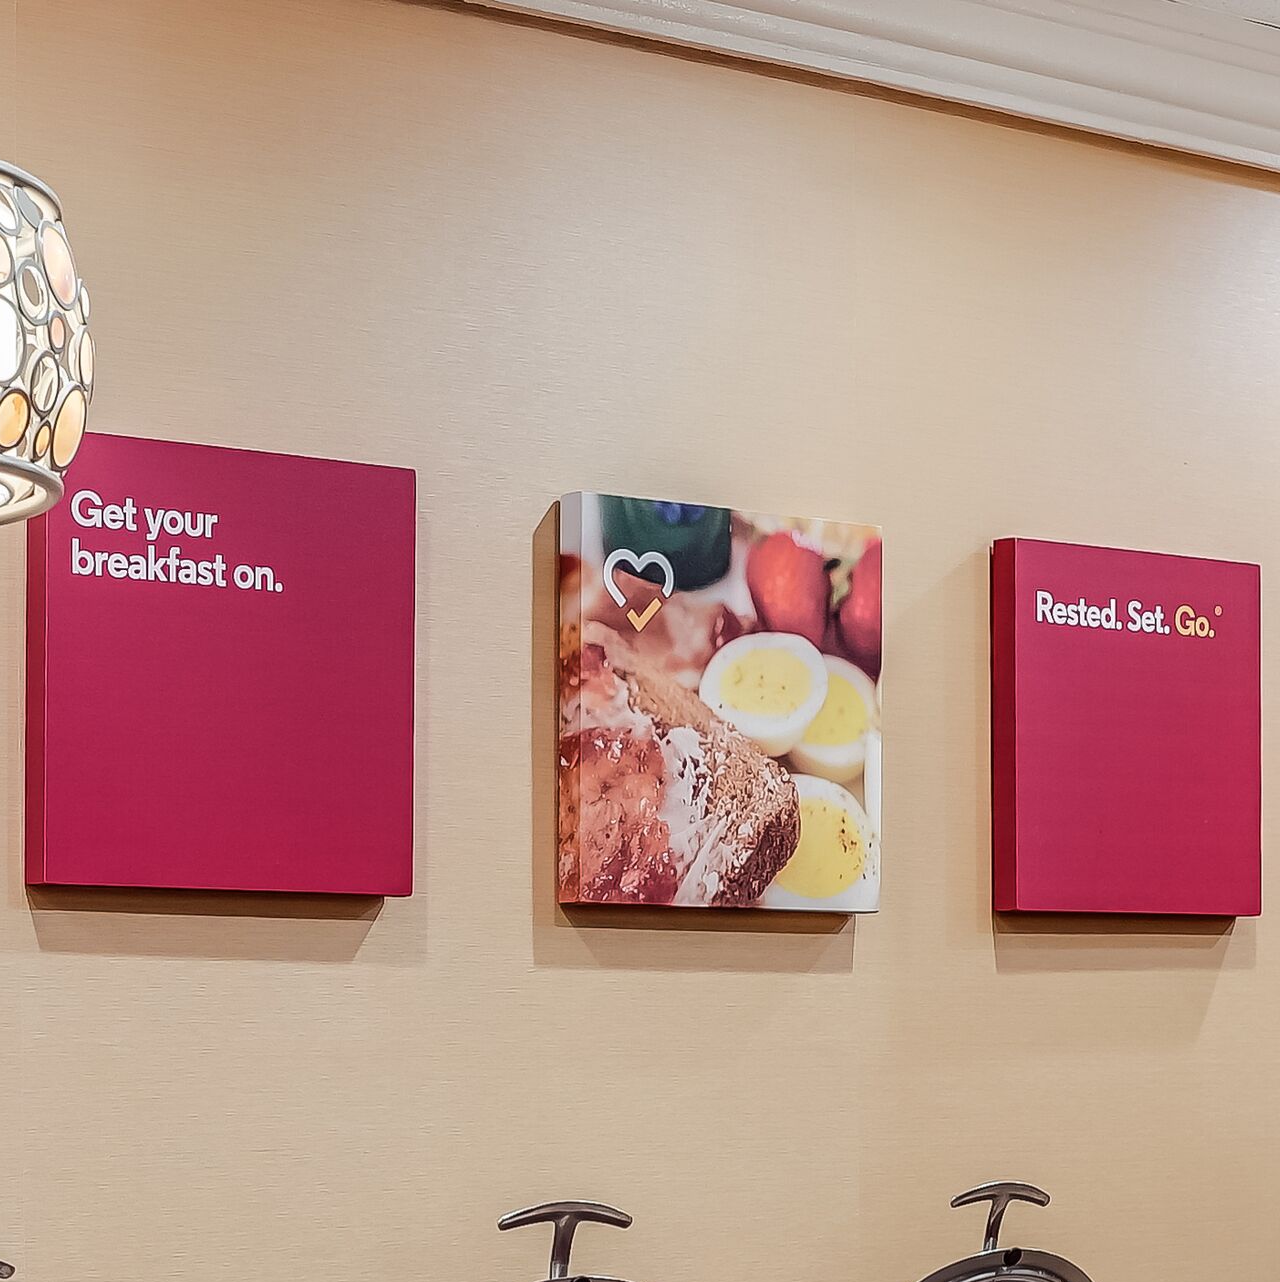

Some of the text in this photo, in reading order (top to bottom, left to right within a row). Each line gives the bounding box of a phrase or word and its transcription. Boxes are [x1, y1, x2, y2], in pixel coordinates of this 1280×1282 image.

[70, 489, 219, 541] Get your
[71, 537, 284, 593] breakfast on.
[1036, 590, 1216, 638] Rested. Set. Go.
